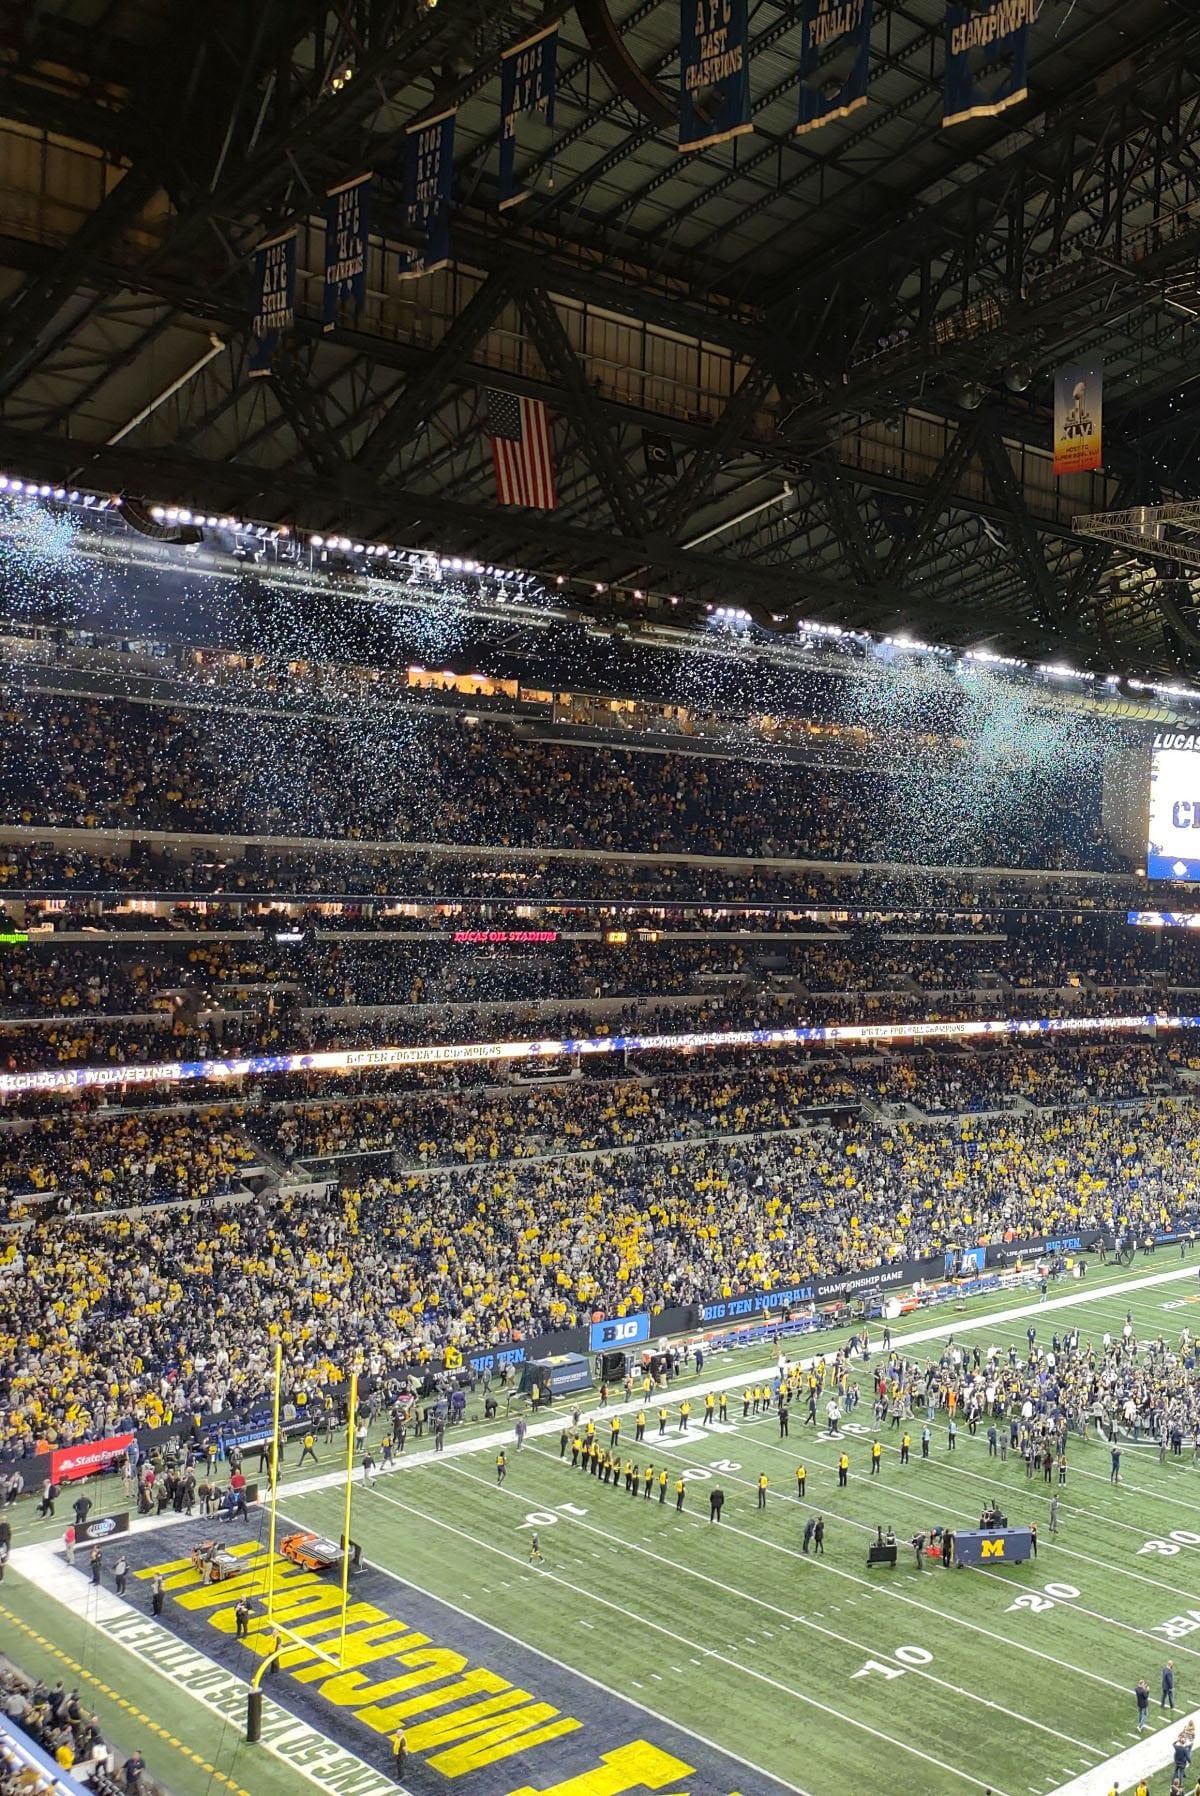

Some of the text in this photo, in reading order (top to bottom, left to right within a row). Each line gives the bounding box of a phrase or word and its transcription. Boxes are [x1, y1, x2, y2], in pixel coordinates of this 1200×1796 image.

[454, 932, 557, 942] LUCAS OIL STADIUM
[86, 1066, 181, 1084] WOLVERINES
[703, 1301, 726, 1321] BIG
[728, 1298, 751, 1317] TEN
[755, 1286, 815, 1311] FOOTBALL
[881, 1270, 903, 1283] GAME
[682, 1458, 743, 1481] 20
[524, 1501, 590, 1526] 10
[981, 1539, 1005, 1558] M
[1014, 1582, 1081, 1613] 20
[133, 1540, 584, 1780] MICHIGAN
[863, 1645, 934, 1680] 10
